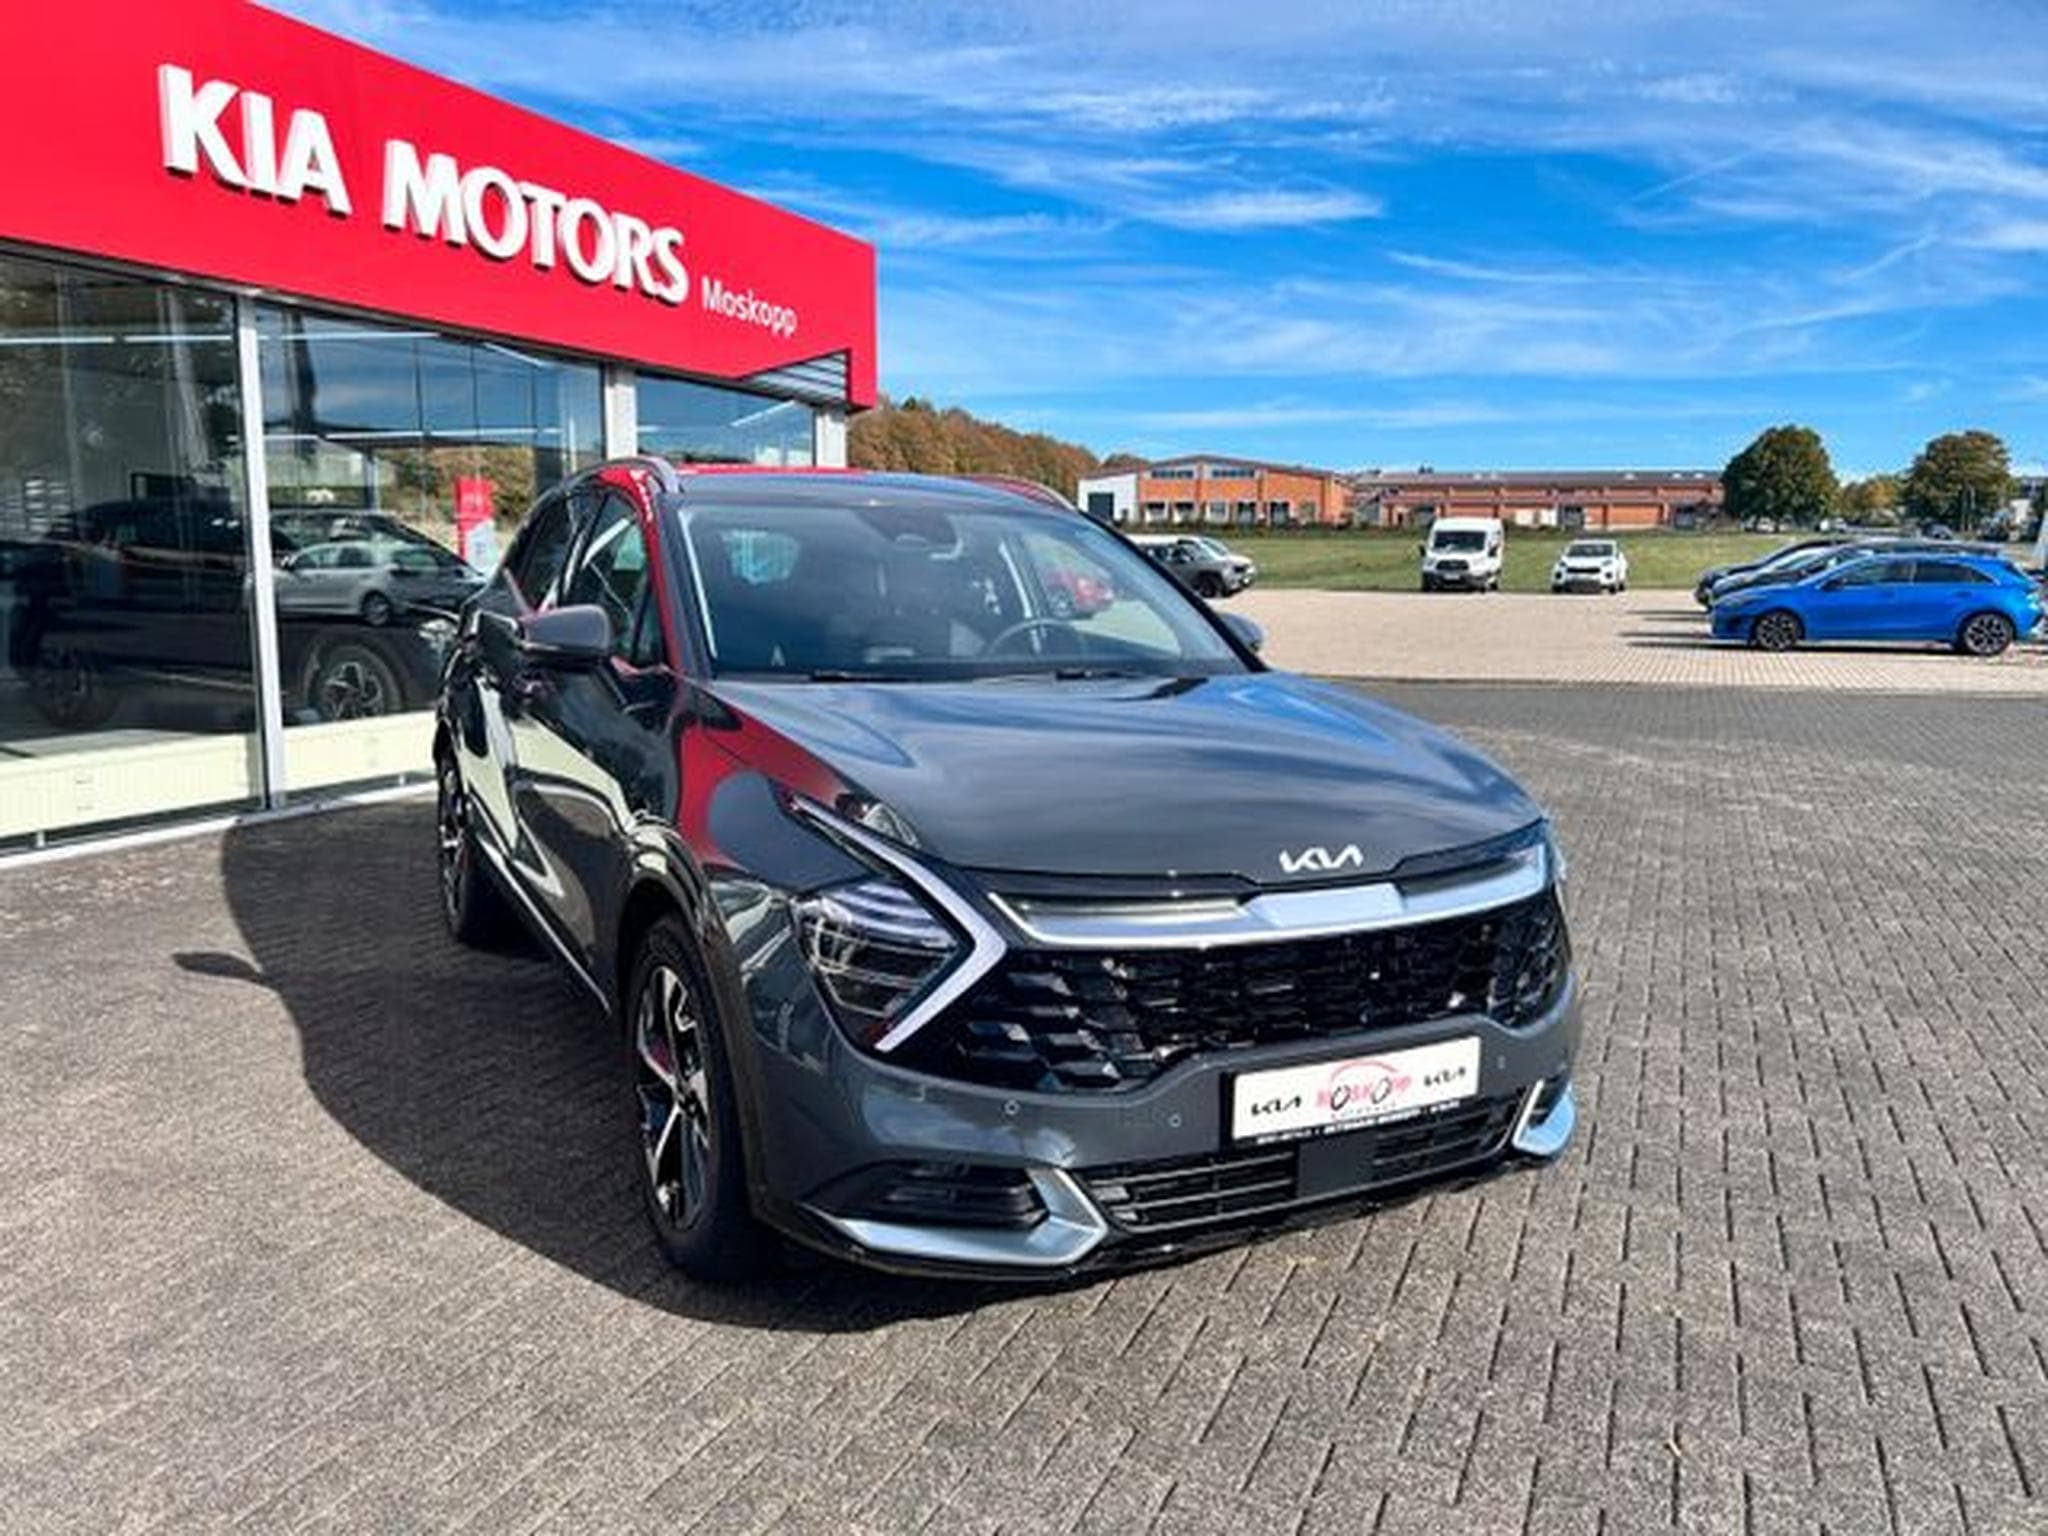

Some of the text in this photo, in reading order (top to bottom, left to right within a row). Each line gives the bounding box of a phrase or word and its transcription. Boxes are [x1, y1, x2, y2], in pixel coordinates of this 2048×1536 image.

[157, 63, 690, 304] KIA MOTORS
[702, 275, 798, 338] Moskopp
[1279, 843, 1363, 874] KIA
